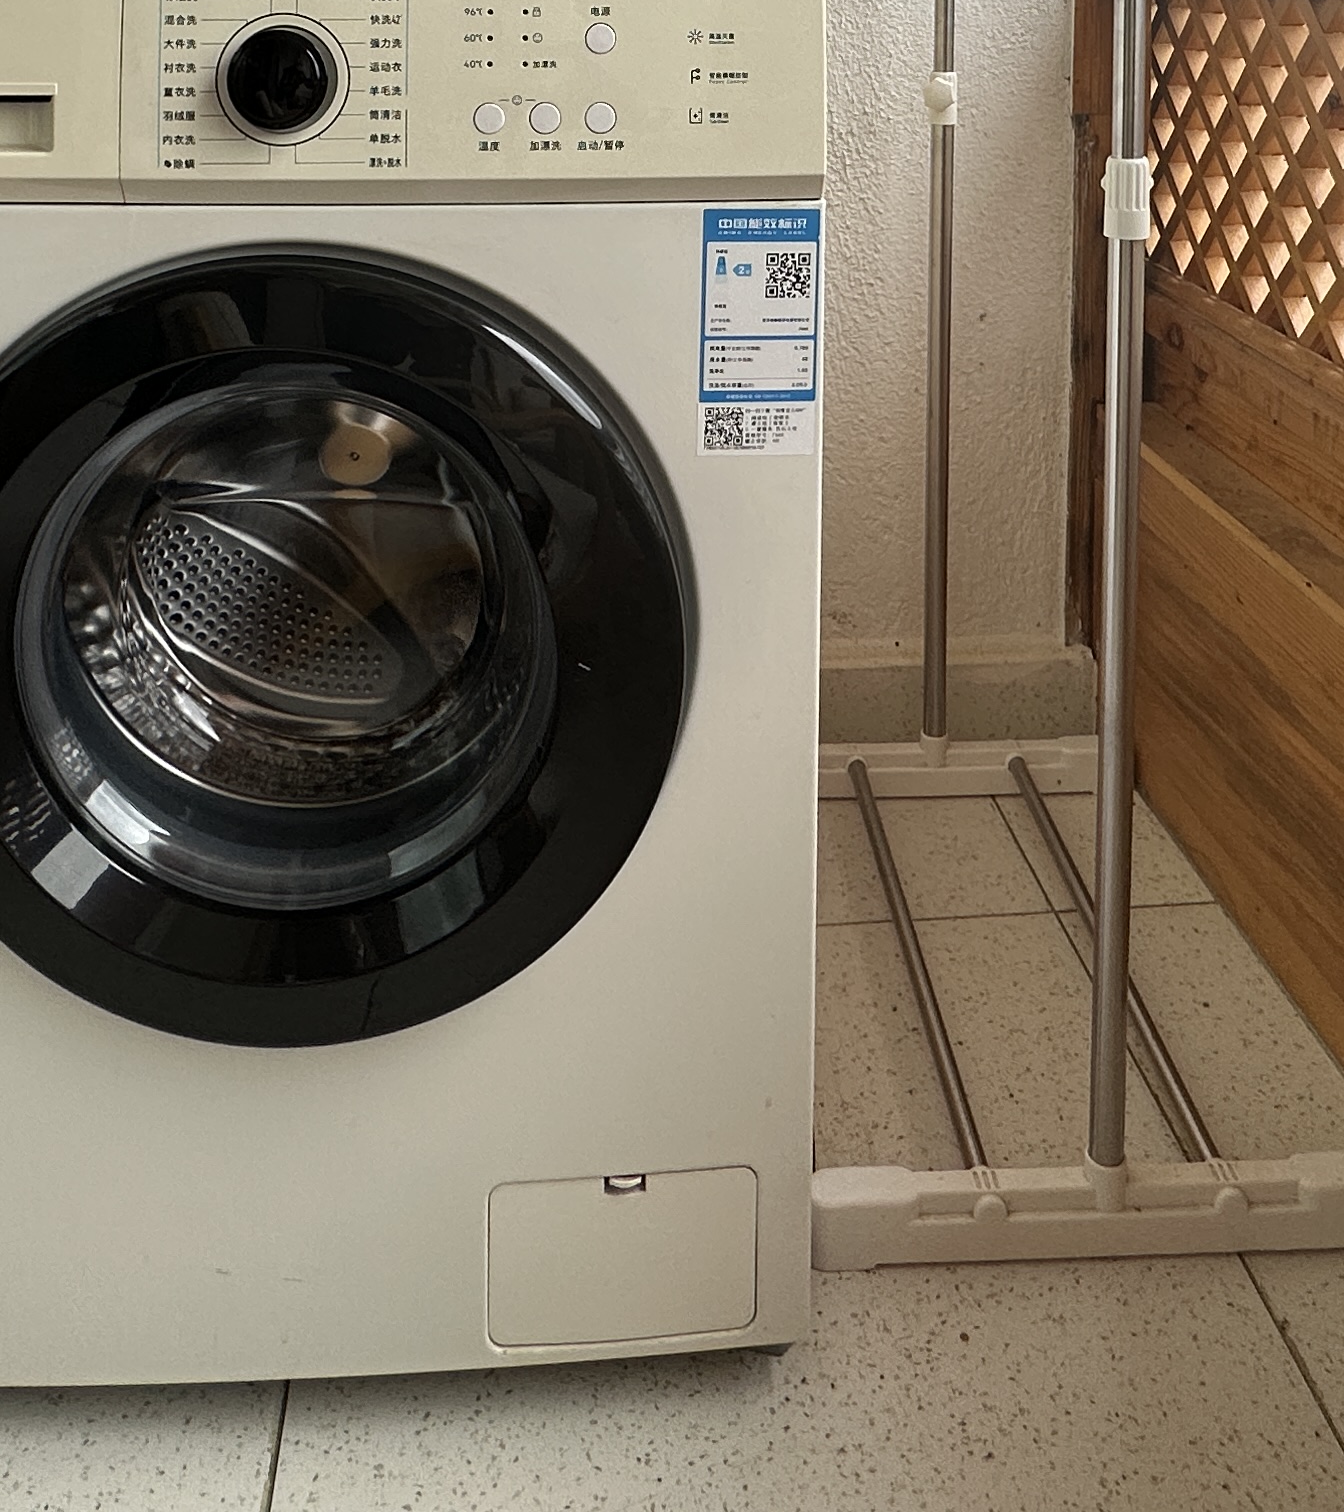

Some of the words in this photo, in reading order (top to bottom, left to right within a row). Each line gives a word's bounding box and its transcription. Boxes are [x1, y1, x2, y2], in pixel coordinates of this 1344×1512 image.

[590, 6, 611, 16] 电源
[164, 15, 197, 25] 混合洗
[164, 39, 197, 49] 大件洗
[370, 38, 402, 48] 强力洗
[164, 63, 196, 73] 衬衣洗
[369, 62, 402, 72] 运动衣
[369, 85, 402, 96] 羊毛洗
[163, 111, 195, 121] 羽绒服
[162, 135, 196, 145] 内衣洗
[369, 133, 402, 143] 单脱水
[478, 141, 500, 151] 温度
[529, 141, 561, 151] 加漂洗
[577, 140, 624, 151] 启动/暂停
[718, 218, 807, 228] 中国能效标识
